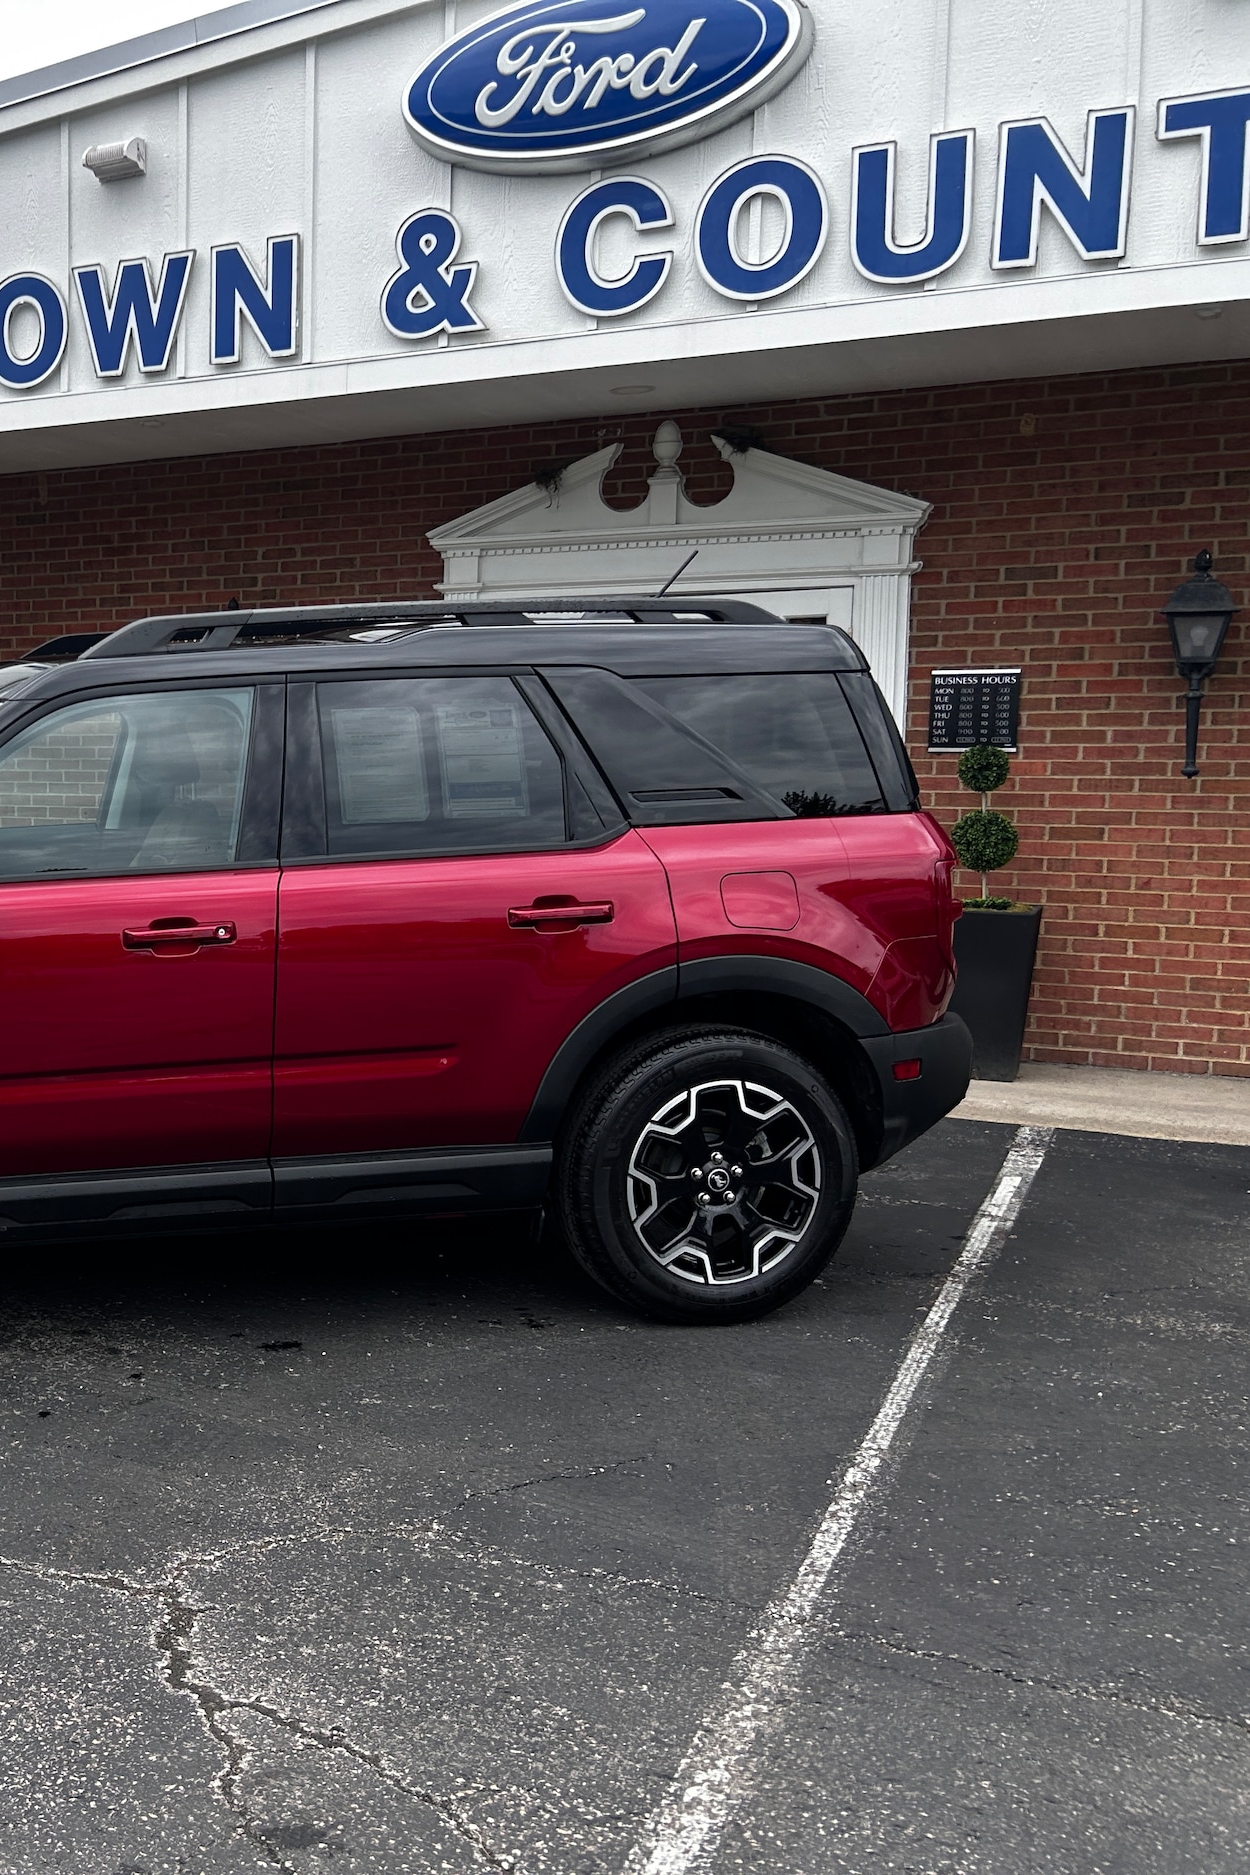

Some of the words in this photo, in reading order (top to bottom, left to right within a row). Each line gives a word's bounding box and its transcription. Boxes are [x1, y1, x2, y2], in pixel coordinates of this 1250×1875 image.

[474, 7, 706, 128] Ford
[379, 206, 489, 341] &
[555, 86, 1250, 320] COUNT
[934, 676, 978, 685] BUSINESS
[981, 675, 1017, 684] HOURS
